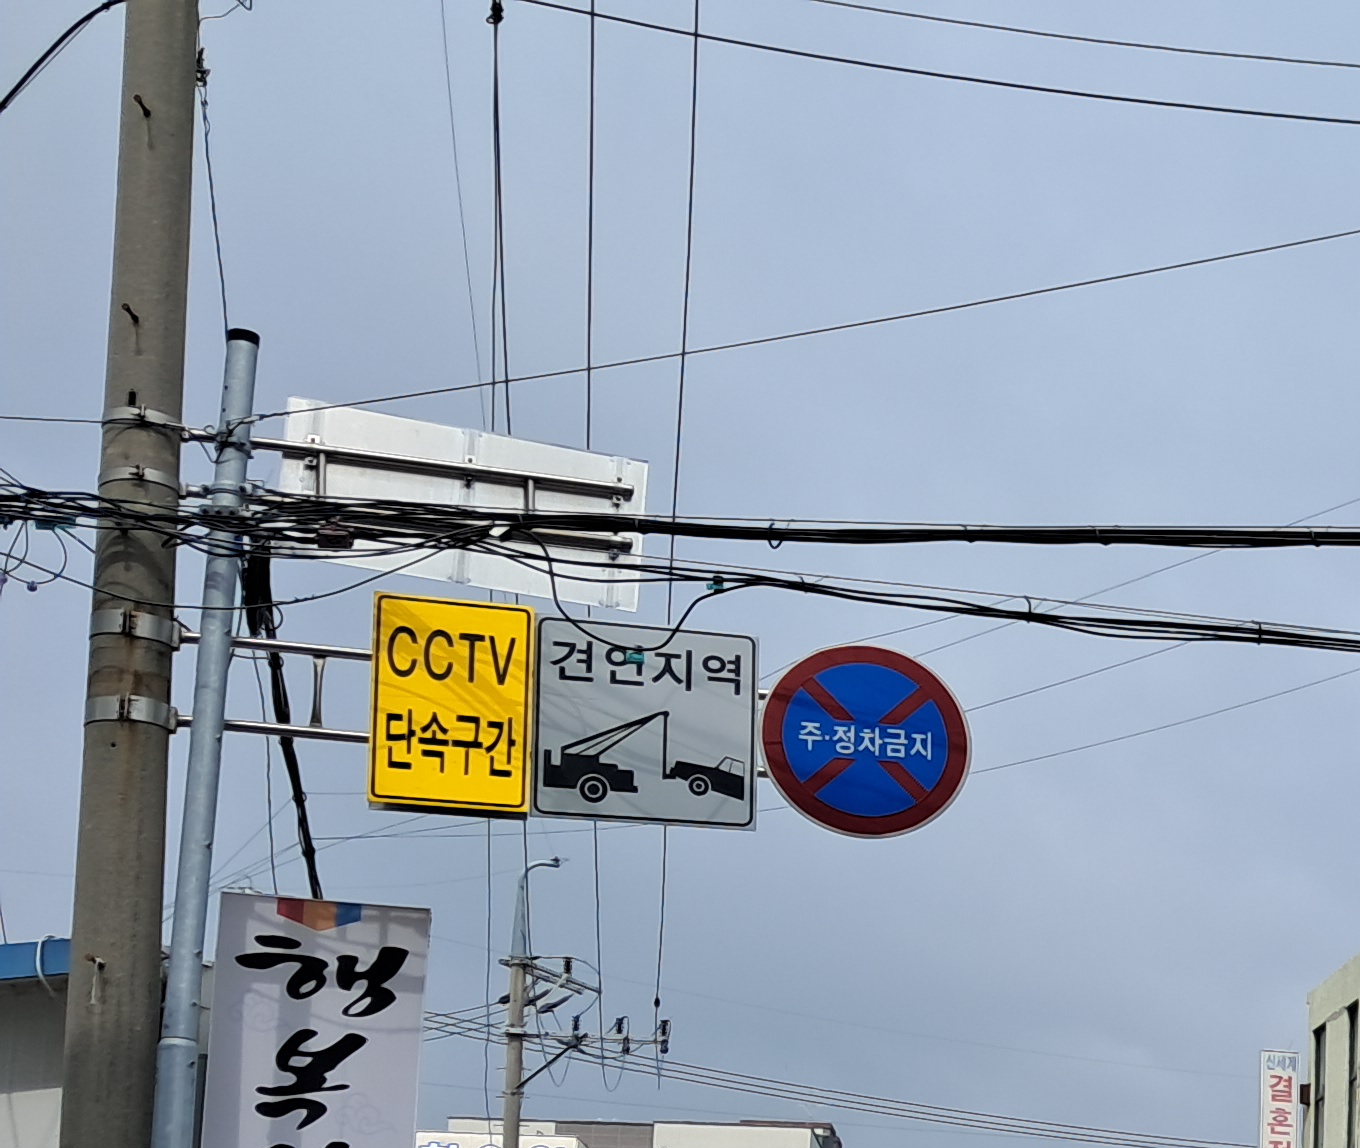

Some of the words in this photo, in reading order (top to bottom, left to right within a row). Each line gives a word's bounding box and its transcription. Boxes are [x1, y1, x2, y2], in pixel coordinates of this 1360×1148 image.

[387, 625, 517, 686] CCTV
[549, 638, 742, 696] 견인지역
[385, 708, 517, 778] 단속구간
[799, 720, 933, 761] 주·정차금지
